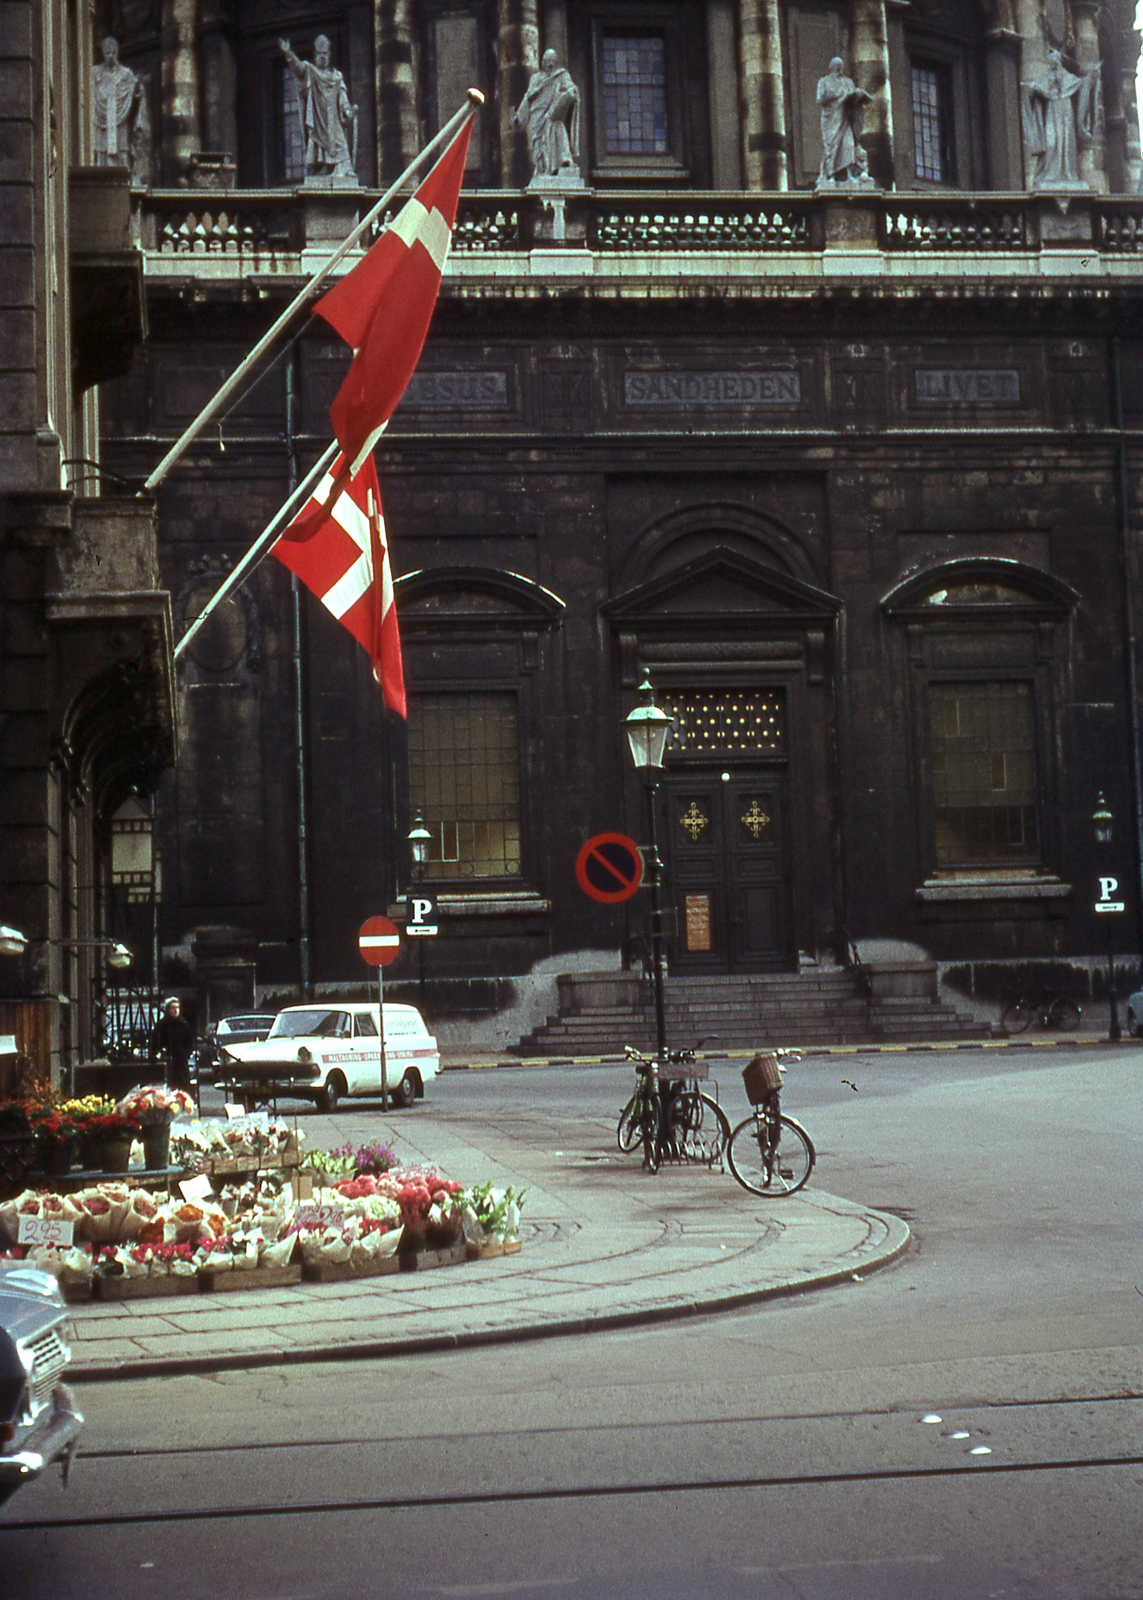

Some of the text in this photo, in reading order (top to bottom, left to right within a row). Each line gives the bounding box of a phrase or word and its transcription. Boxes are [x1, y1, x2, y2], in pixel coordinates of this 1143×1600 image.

[630, 377, 798, 400] SANDHEDEN
[925, 375, 1013, 398] LIVET
[1098, 877, 1118, 901] P
[411, 899, 433, 923] P
